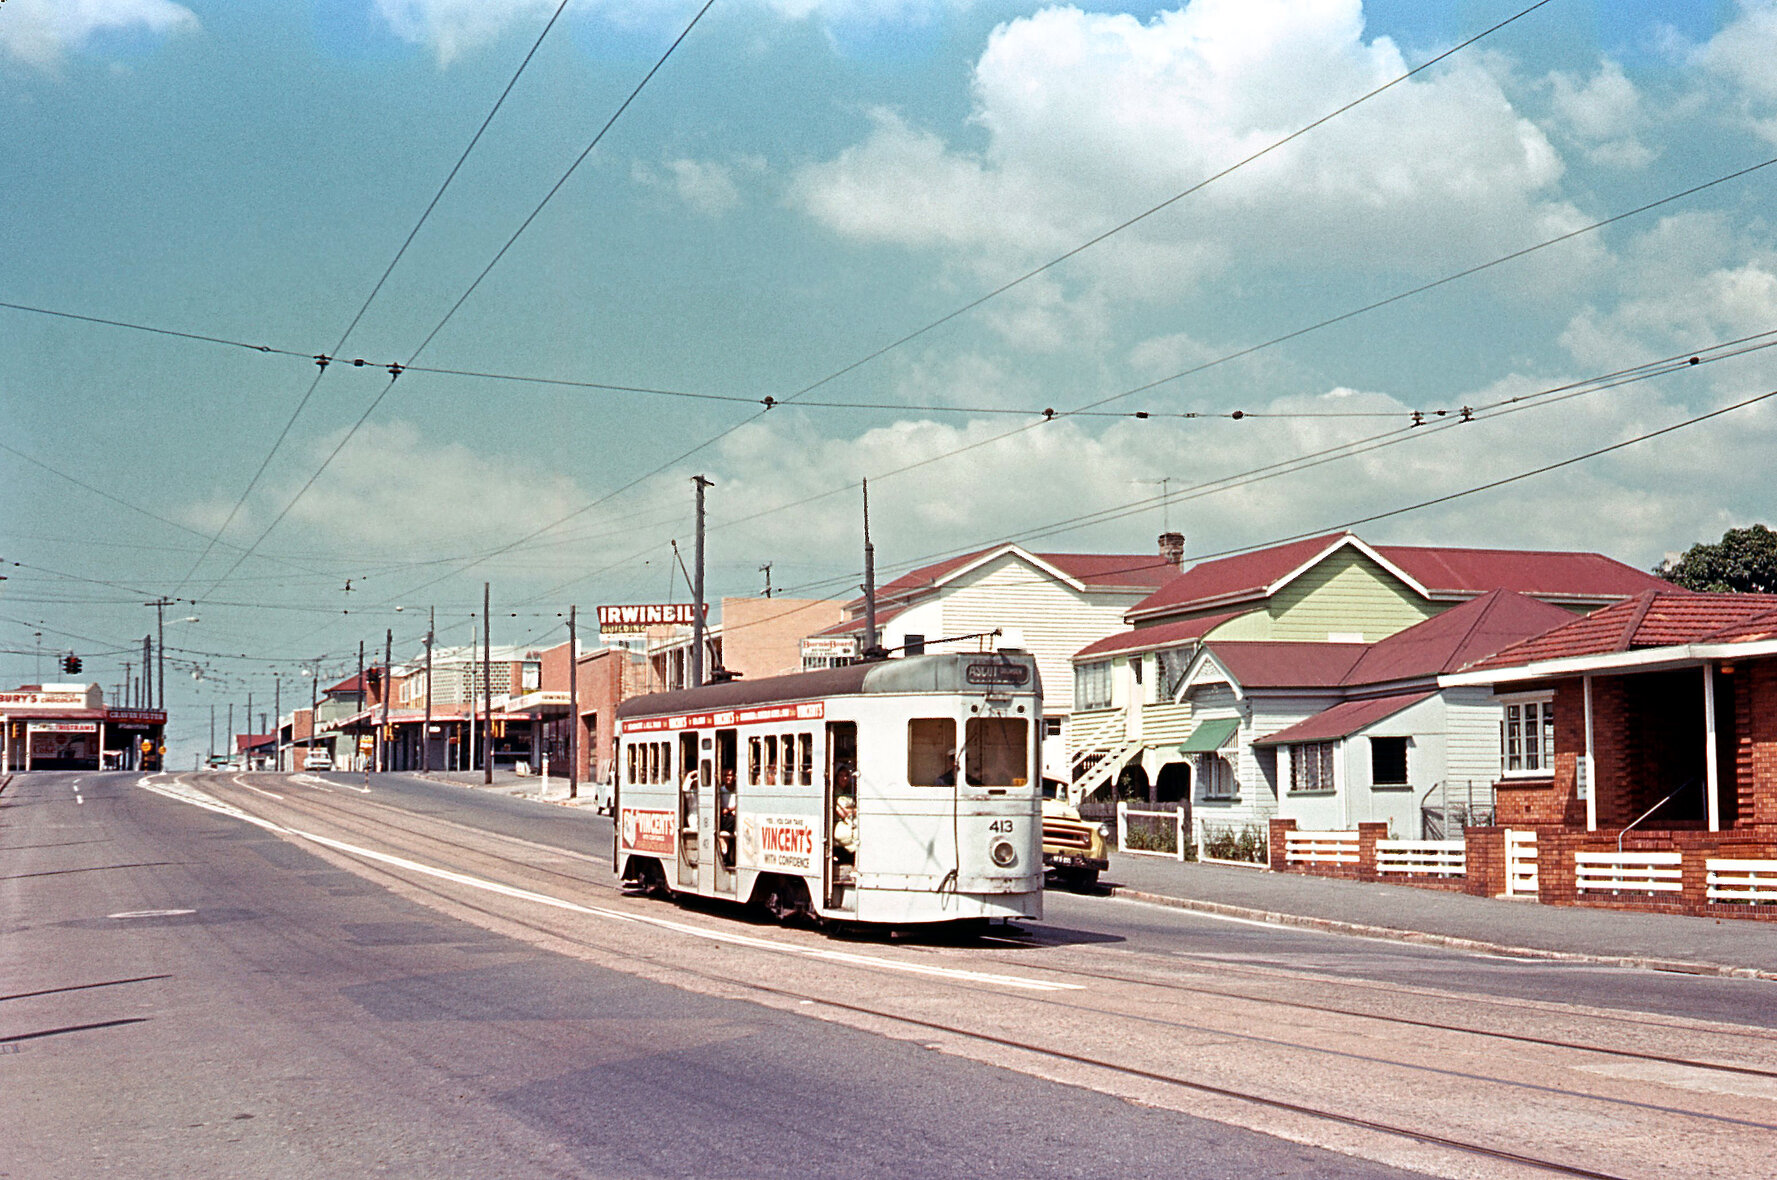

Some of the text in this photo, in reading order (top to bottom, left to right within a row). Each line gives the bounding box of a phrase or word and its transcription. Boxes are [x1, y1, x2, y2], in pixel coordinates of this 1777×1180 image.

[602, 625, 646, 633] BUILDING
[990, 820, 1013, 833] 413
[762, 826, 812, 854] VINCENT'S
[764, 854, 810, 869] WITH CONFIDENCE
